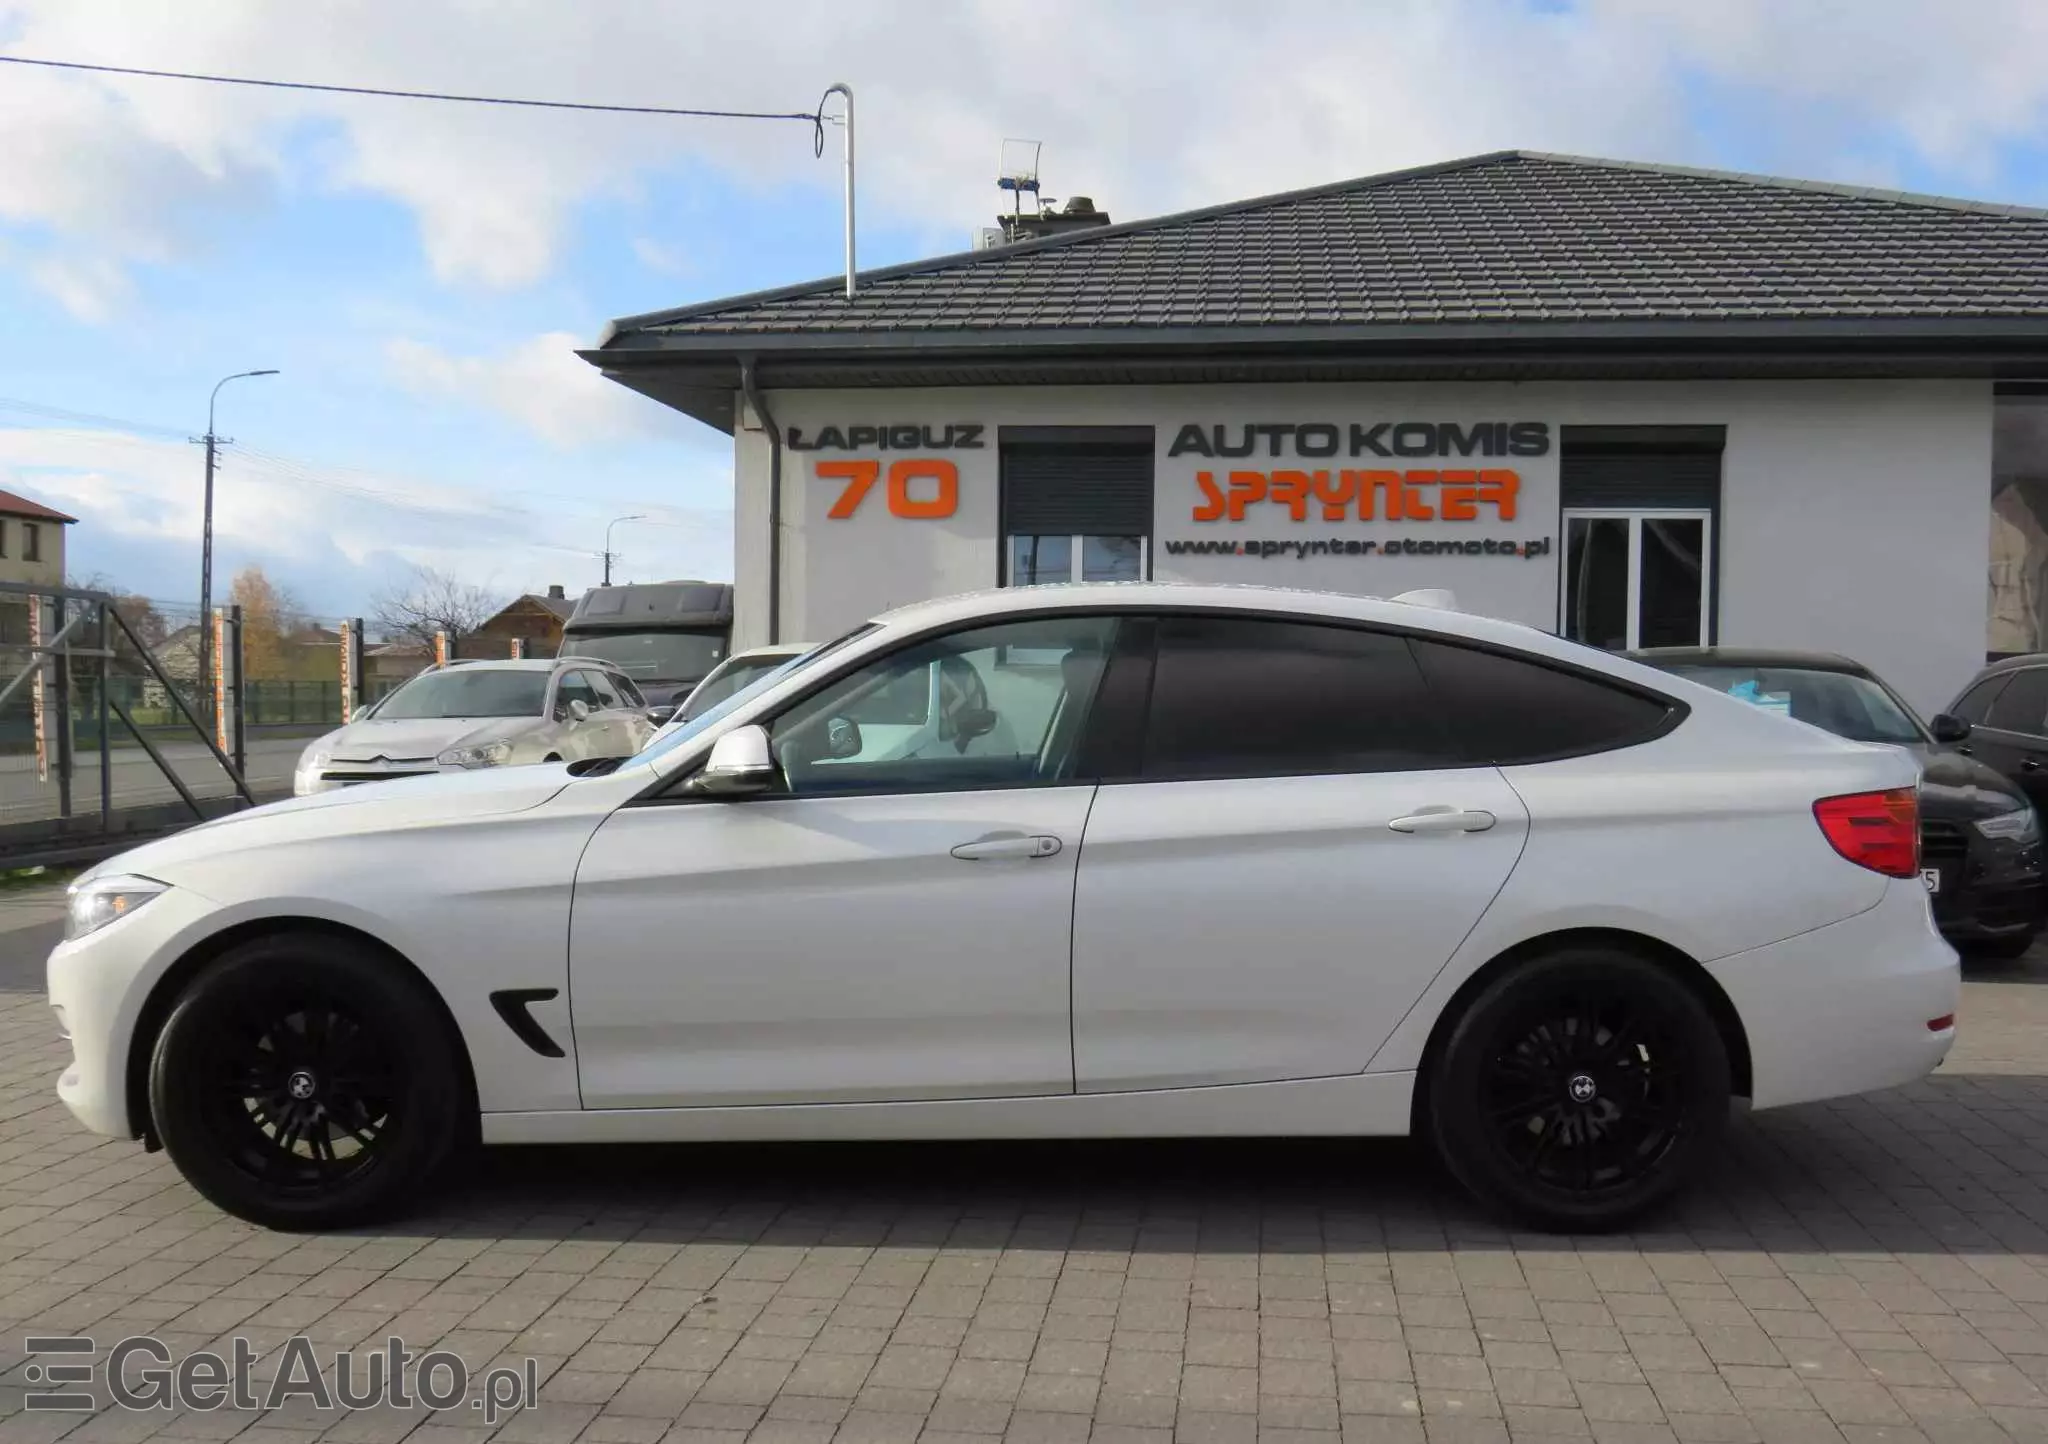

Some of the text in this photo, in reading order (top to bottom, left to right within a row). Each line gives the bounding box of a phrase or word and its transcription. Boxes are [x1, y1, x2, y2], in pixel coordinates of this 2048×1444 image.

[788, 425, 984, 450] ŁAPIGUZ
[1167, 422, 1550, 457] AUTO KOMIS
[815, 460, 959, 519] 70
[1192, 469, 1521, 522] SPRYNTER
[1165, 537, 1550, 560] www.sprynter.otomoto.pl
